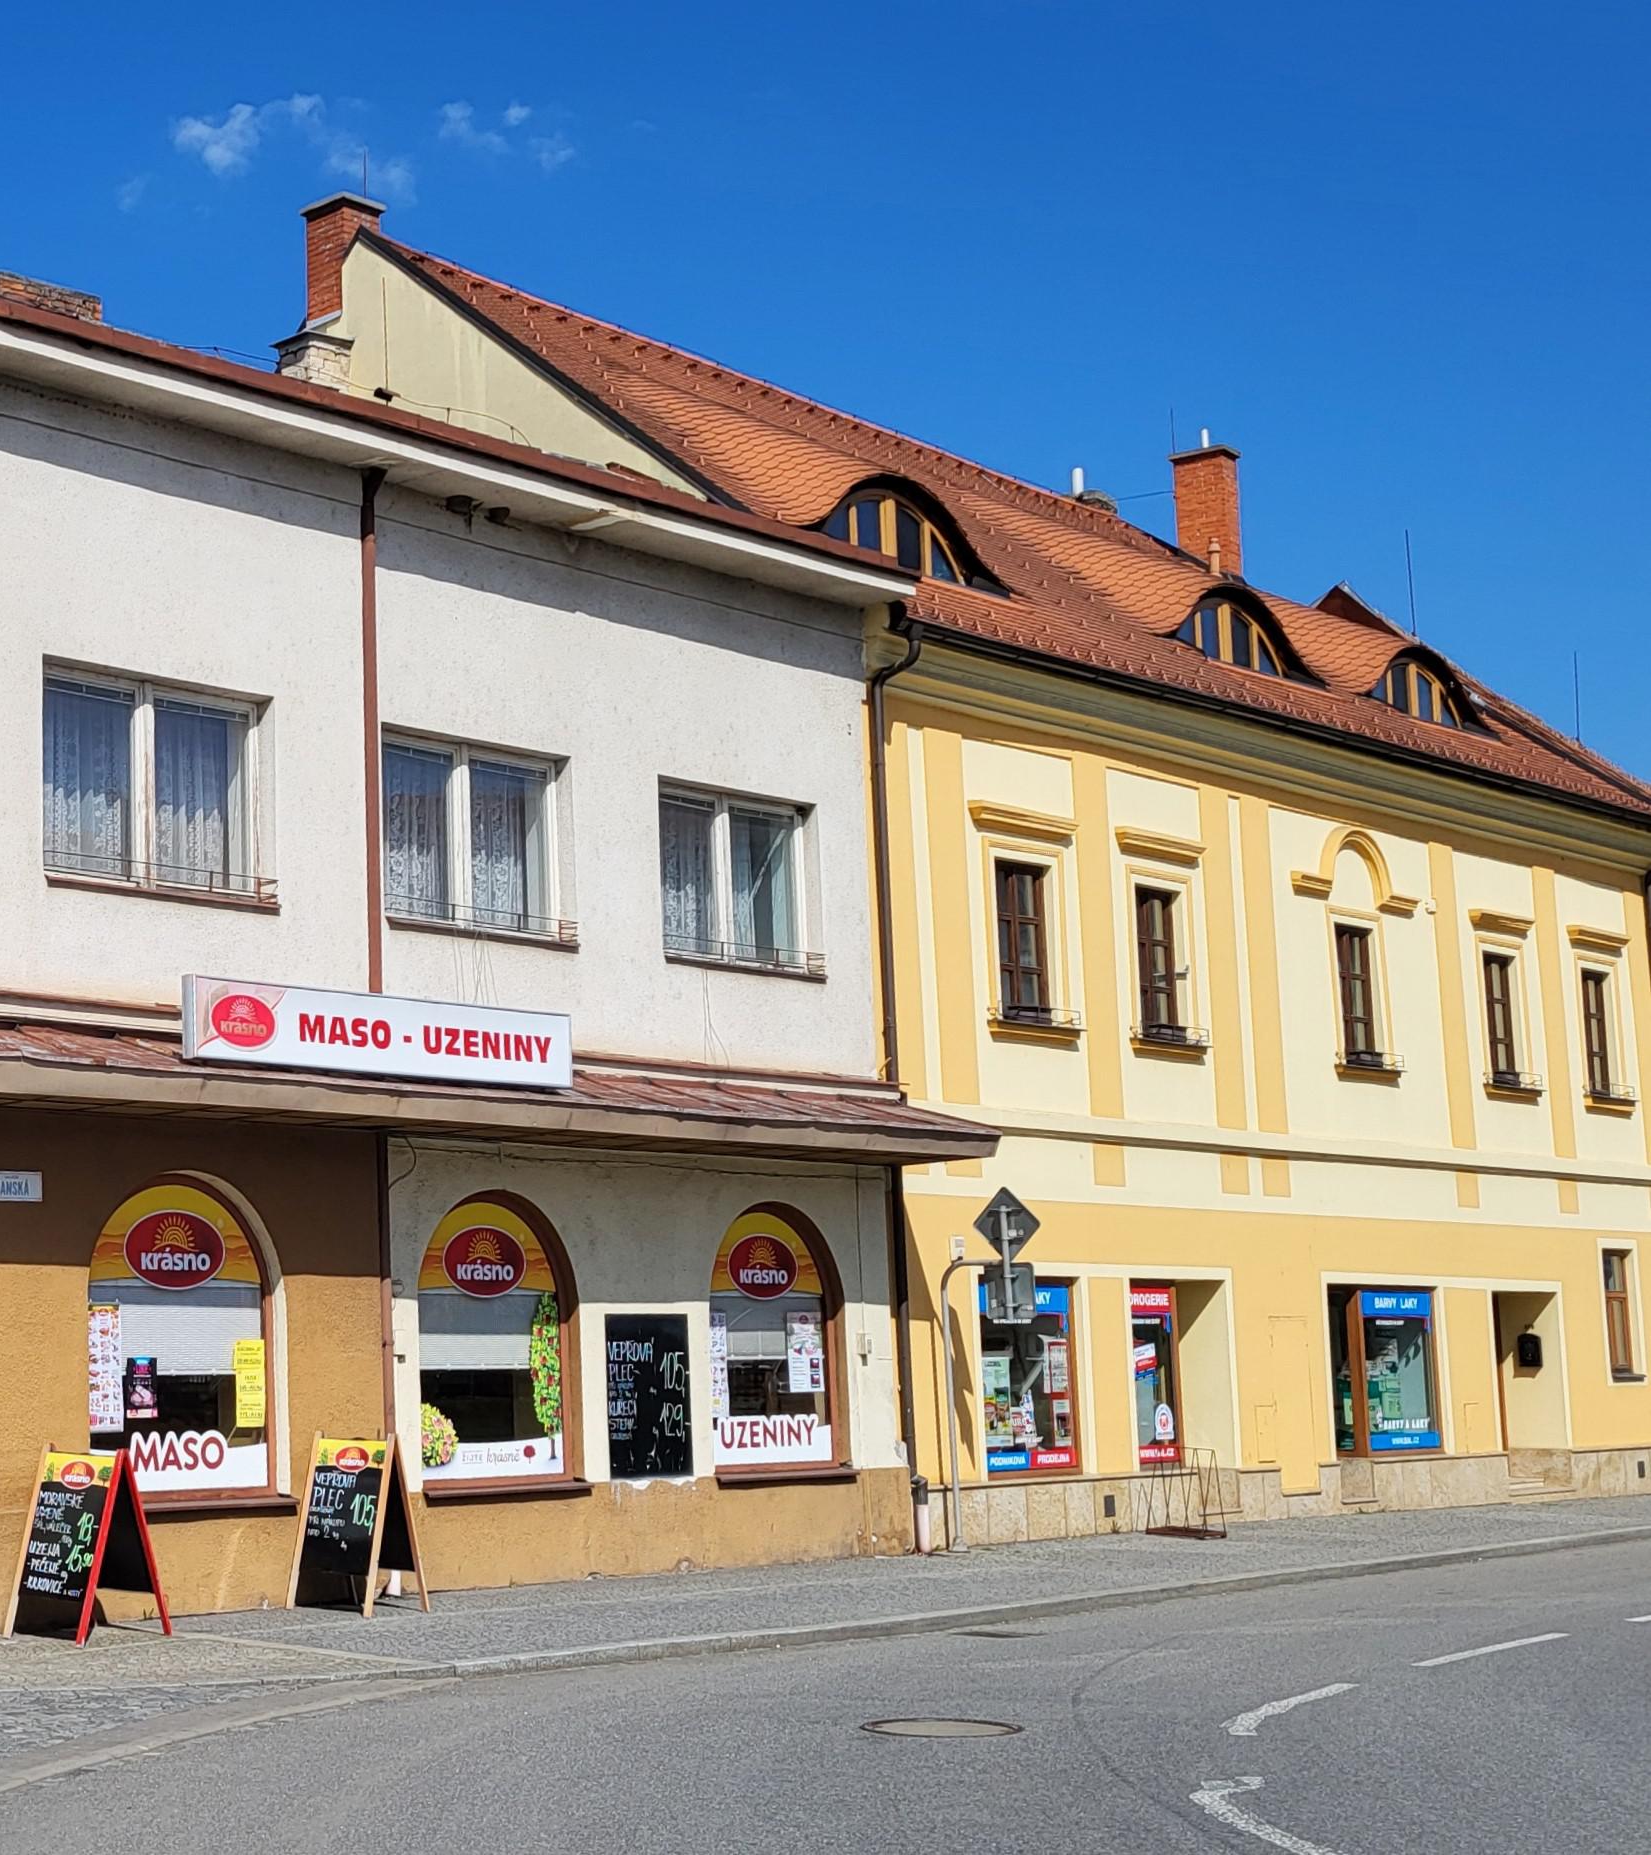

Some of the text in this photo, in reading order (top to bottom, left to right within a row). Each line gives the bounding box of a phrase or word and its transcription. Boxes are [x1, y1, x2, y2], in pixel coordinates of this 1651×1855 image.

[299, 1013, 392, 1049] MASO
[423, 1024, 552, 1063] UZENINY
[1374, 1297, 1418, 1309] BARVY LAKY
[720, 1419, 816, 1449] UZENINY
[133, 1435, 225, 1473] MASO
[39, 1491, 86, 1510] MORAVSKÉ
[312, 1486, 345, 1510] PLEC
